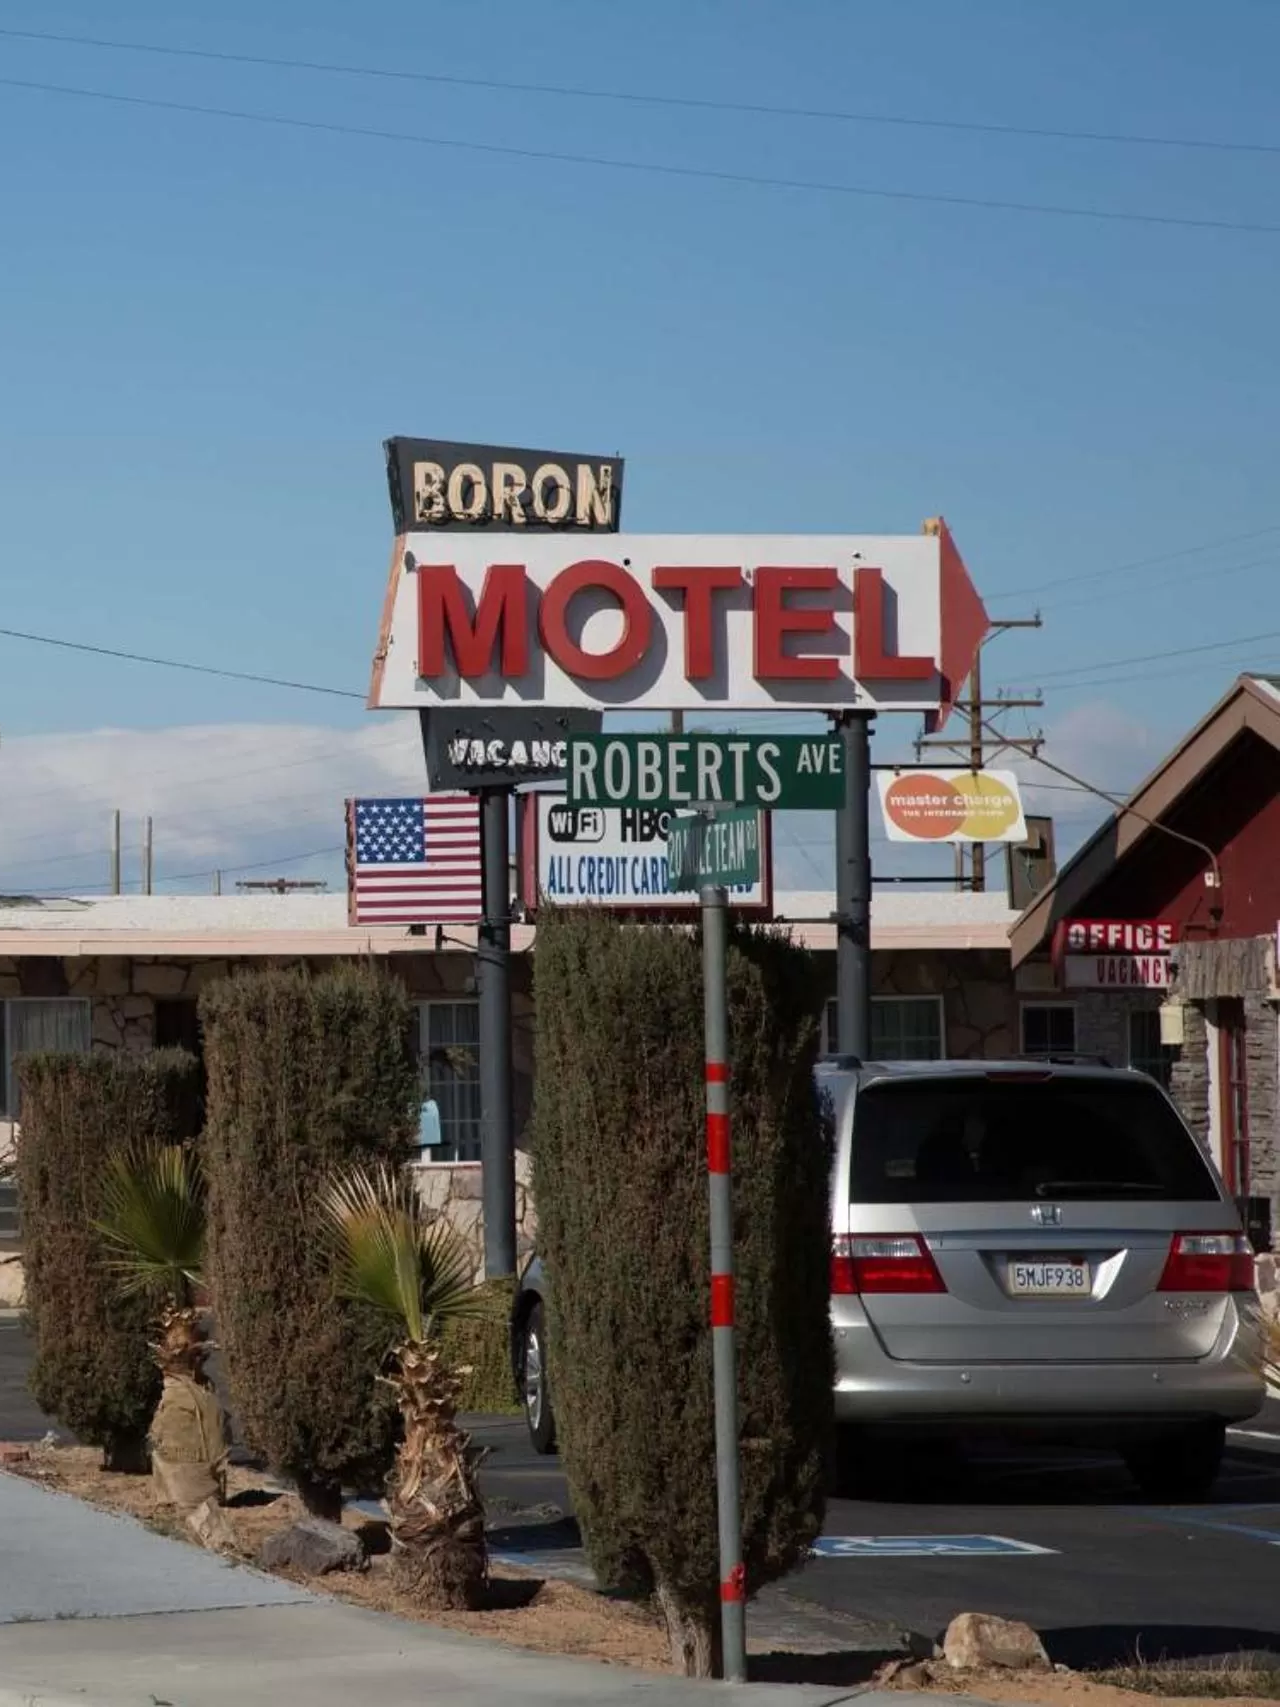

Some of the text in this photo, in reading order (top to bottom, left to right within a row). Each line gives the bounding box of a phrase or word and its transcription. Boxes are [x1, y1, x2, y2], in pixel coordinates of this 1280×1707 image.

[413, 461, 613, 525] BORON
[417, 559, 935, 681] MOTEL
[448, 738, 567, 768] VACANC
[572, 741, 842, 802] ROBERTS AVE
[890, 793, 1013, 809] master charge
[668, 831, 681, 879] 20
[713, 820, 745, 873] TEAM
[548, 855, 670, 895] ALL CREDIT CARD
[1068, 923, 1173, 951] OFFICE
[1016, 1267, 1084, 1287] 5MJF938
